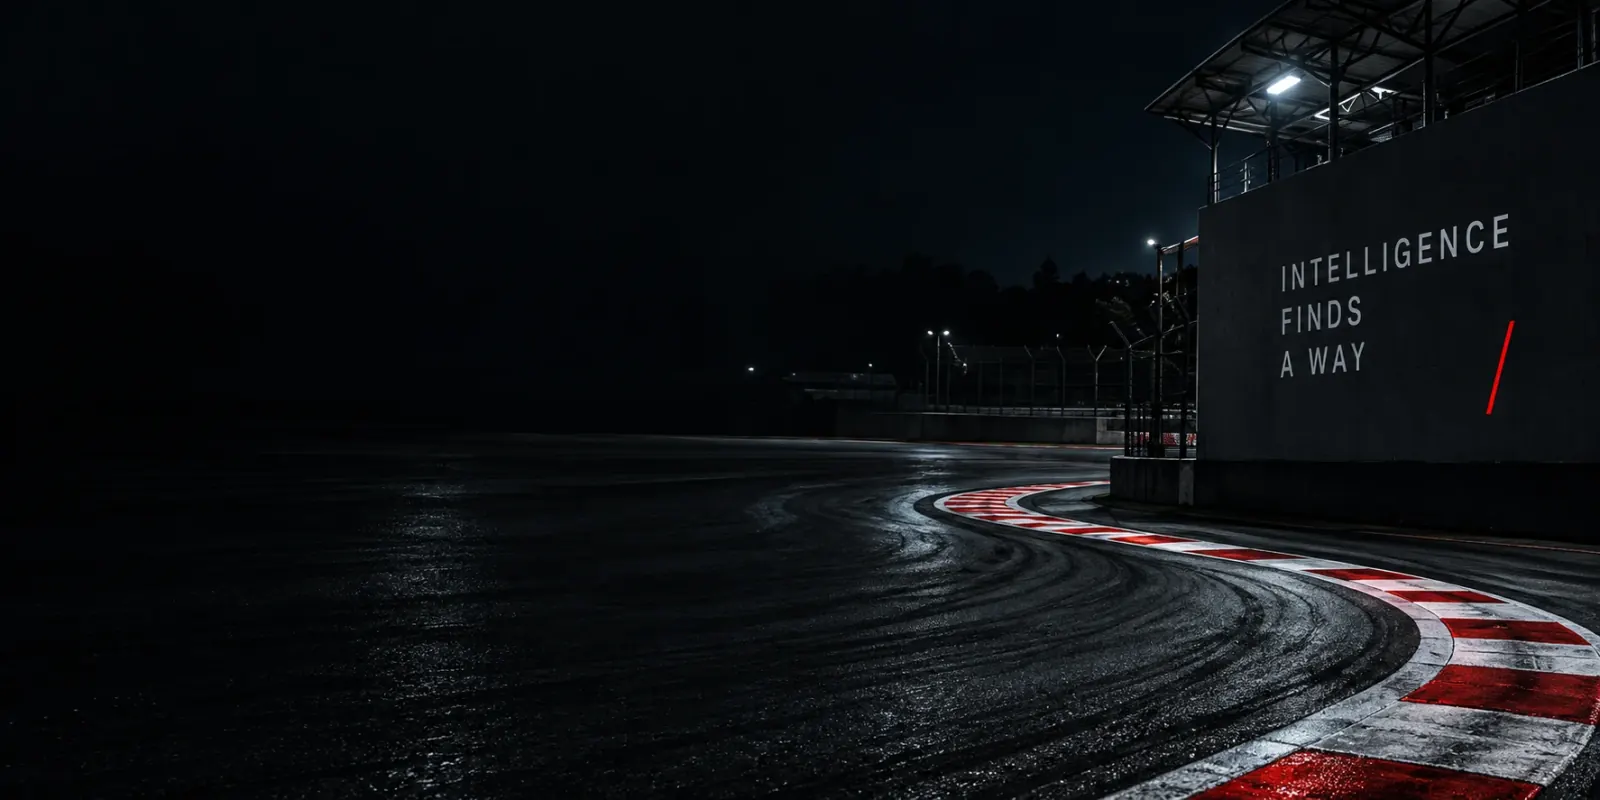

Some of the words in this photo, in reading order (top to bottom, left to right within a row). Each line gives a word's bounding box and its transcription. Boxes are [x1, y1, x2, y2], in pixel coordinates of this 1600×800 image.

[1281, 213, 1509, 292] INTELLIGENCE
[1281, 295, 1362, 335] FINDS
[1280, 350, 1294, 379] A
[1308, 341, 1365, 376] WAY
